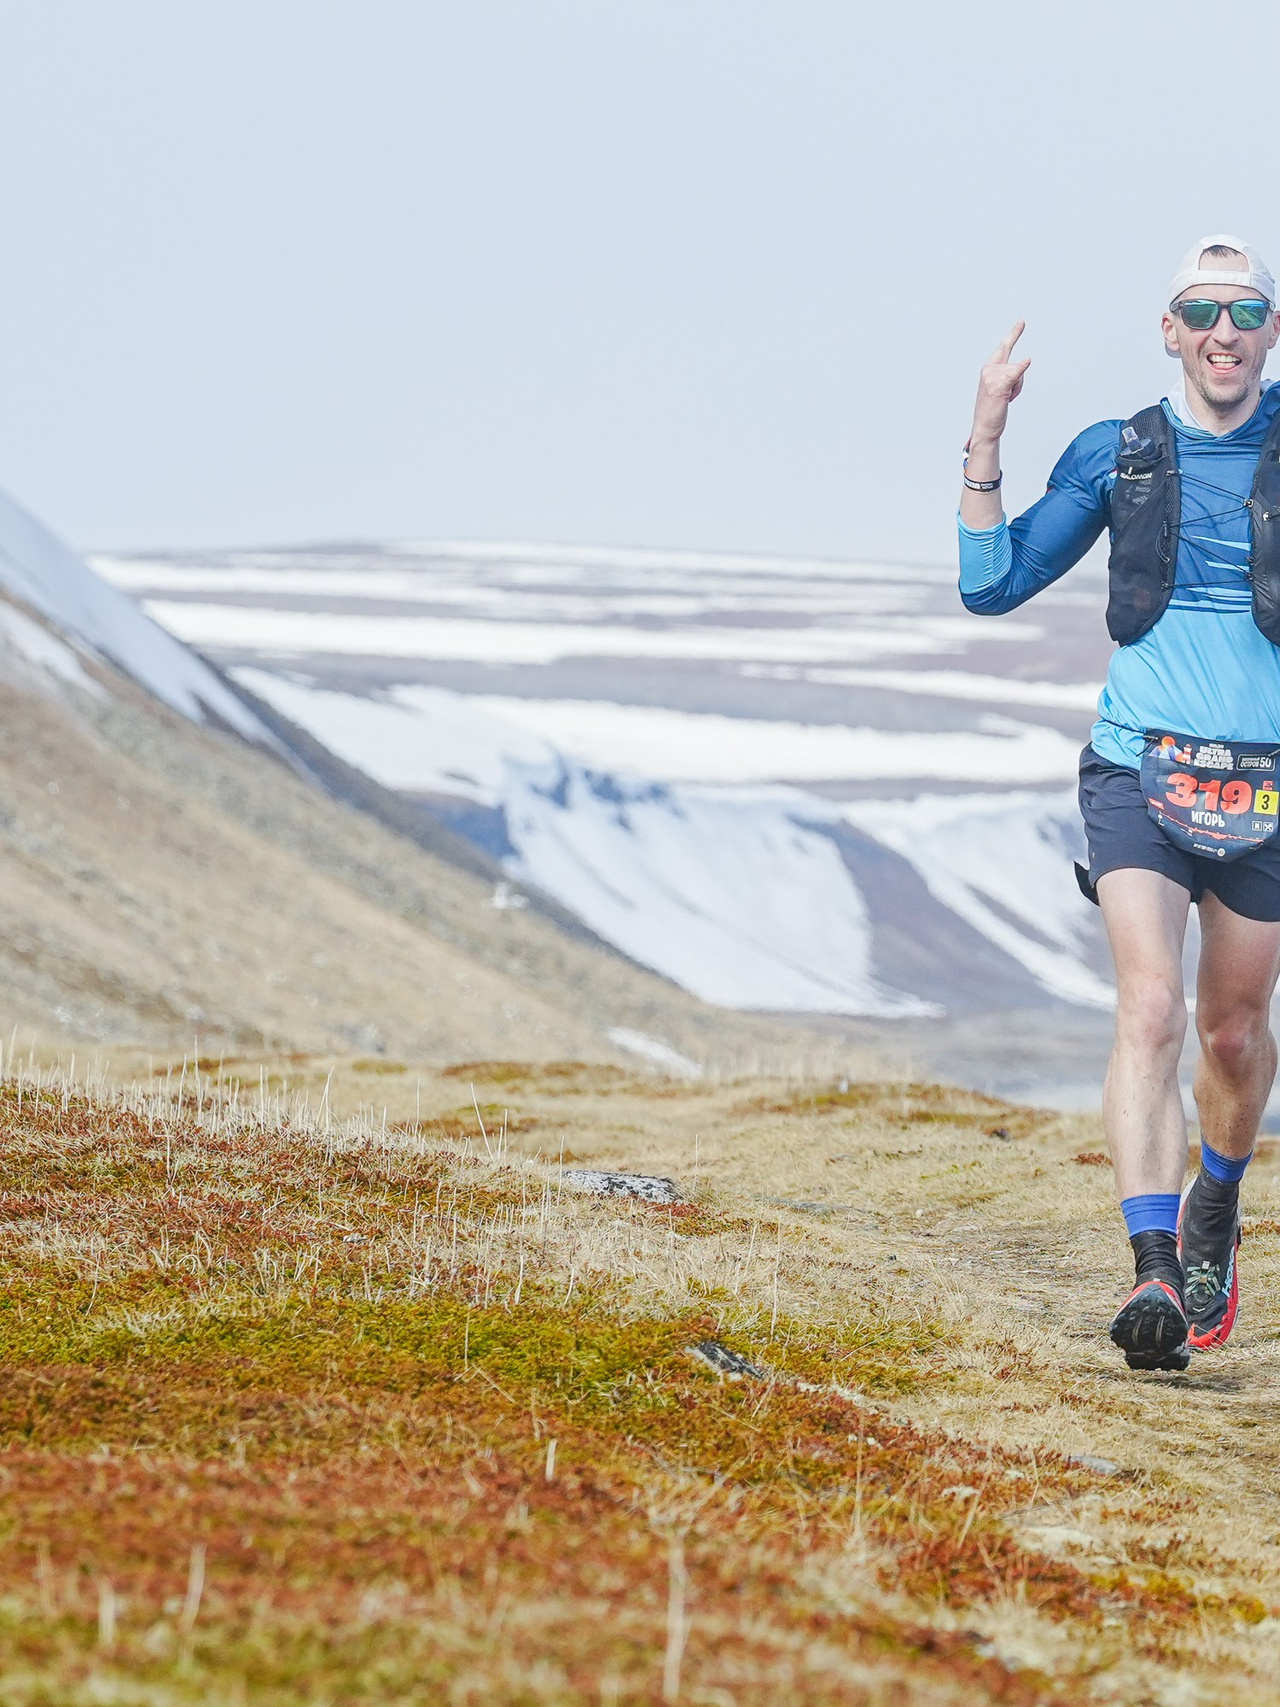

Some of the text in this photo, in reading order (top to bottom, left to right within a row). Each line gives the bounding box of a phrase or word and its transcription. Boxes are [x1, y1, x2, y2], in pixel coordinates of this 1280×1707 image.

[1200, 746, 1231, 756] ULTRA
[1196, 752, 1233, 763] GRAND
[1260, 757, 1272, 768] 50
[1193, 759, 1234, 770] ESCAPE
[1165, 772, 1252, 815] 319
[1261, 794, 1270, 810] 3
[1191, 810, 1226, 828] ИГОРЬ
